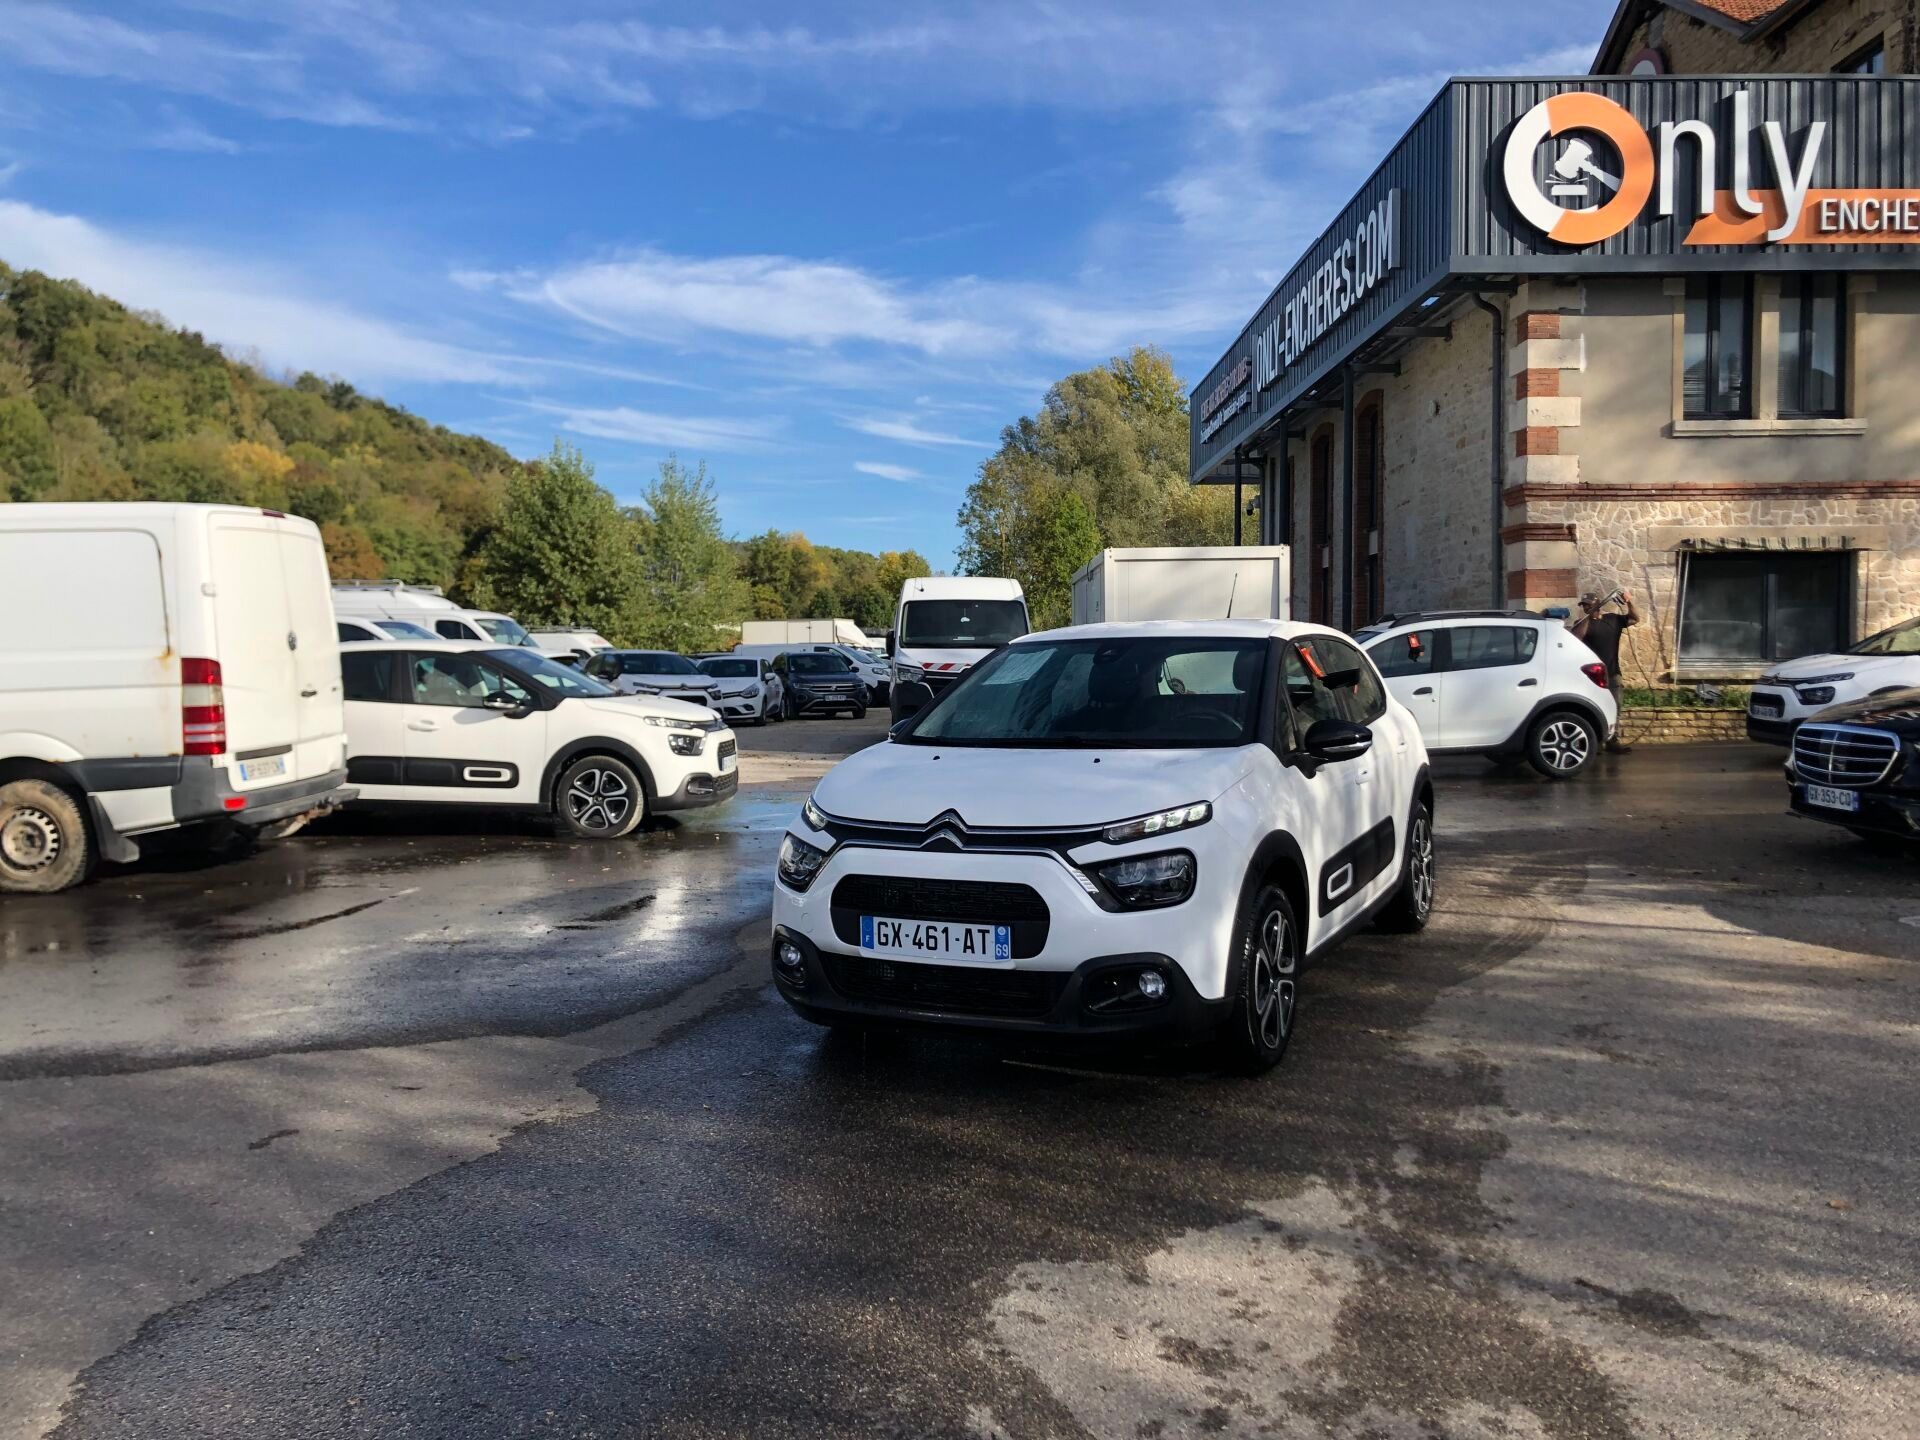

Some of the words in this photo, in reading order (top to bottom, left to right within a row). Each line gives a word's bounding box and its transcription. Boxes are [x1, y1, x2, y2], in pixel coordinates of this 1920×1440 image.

[1504, 90, 1826, 244] Only
[1821, 198, 1920, 231] ENCHE
[1256, 188, 1396, 393] ONLY-ENCHERES.COM
[877, 921, 991, 955] GX-461-AT
[995, 943, 1009, 957] 69
